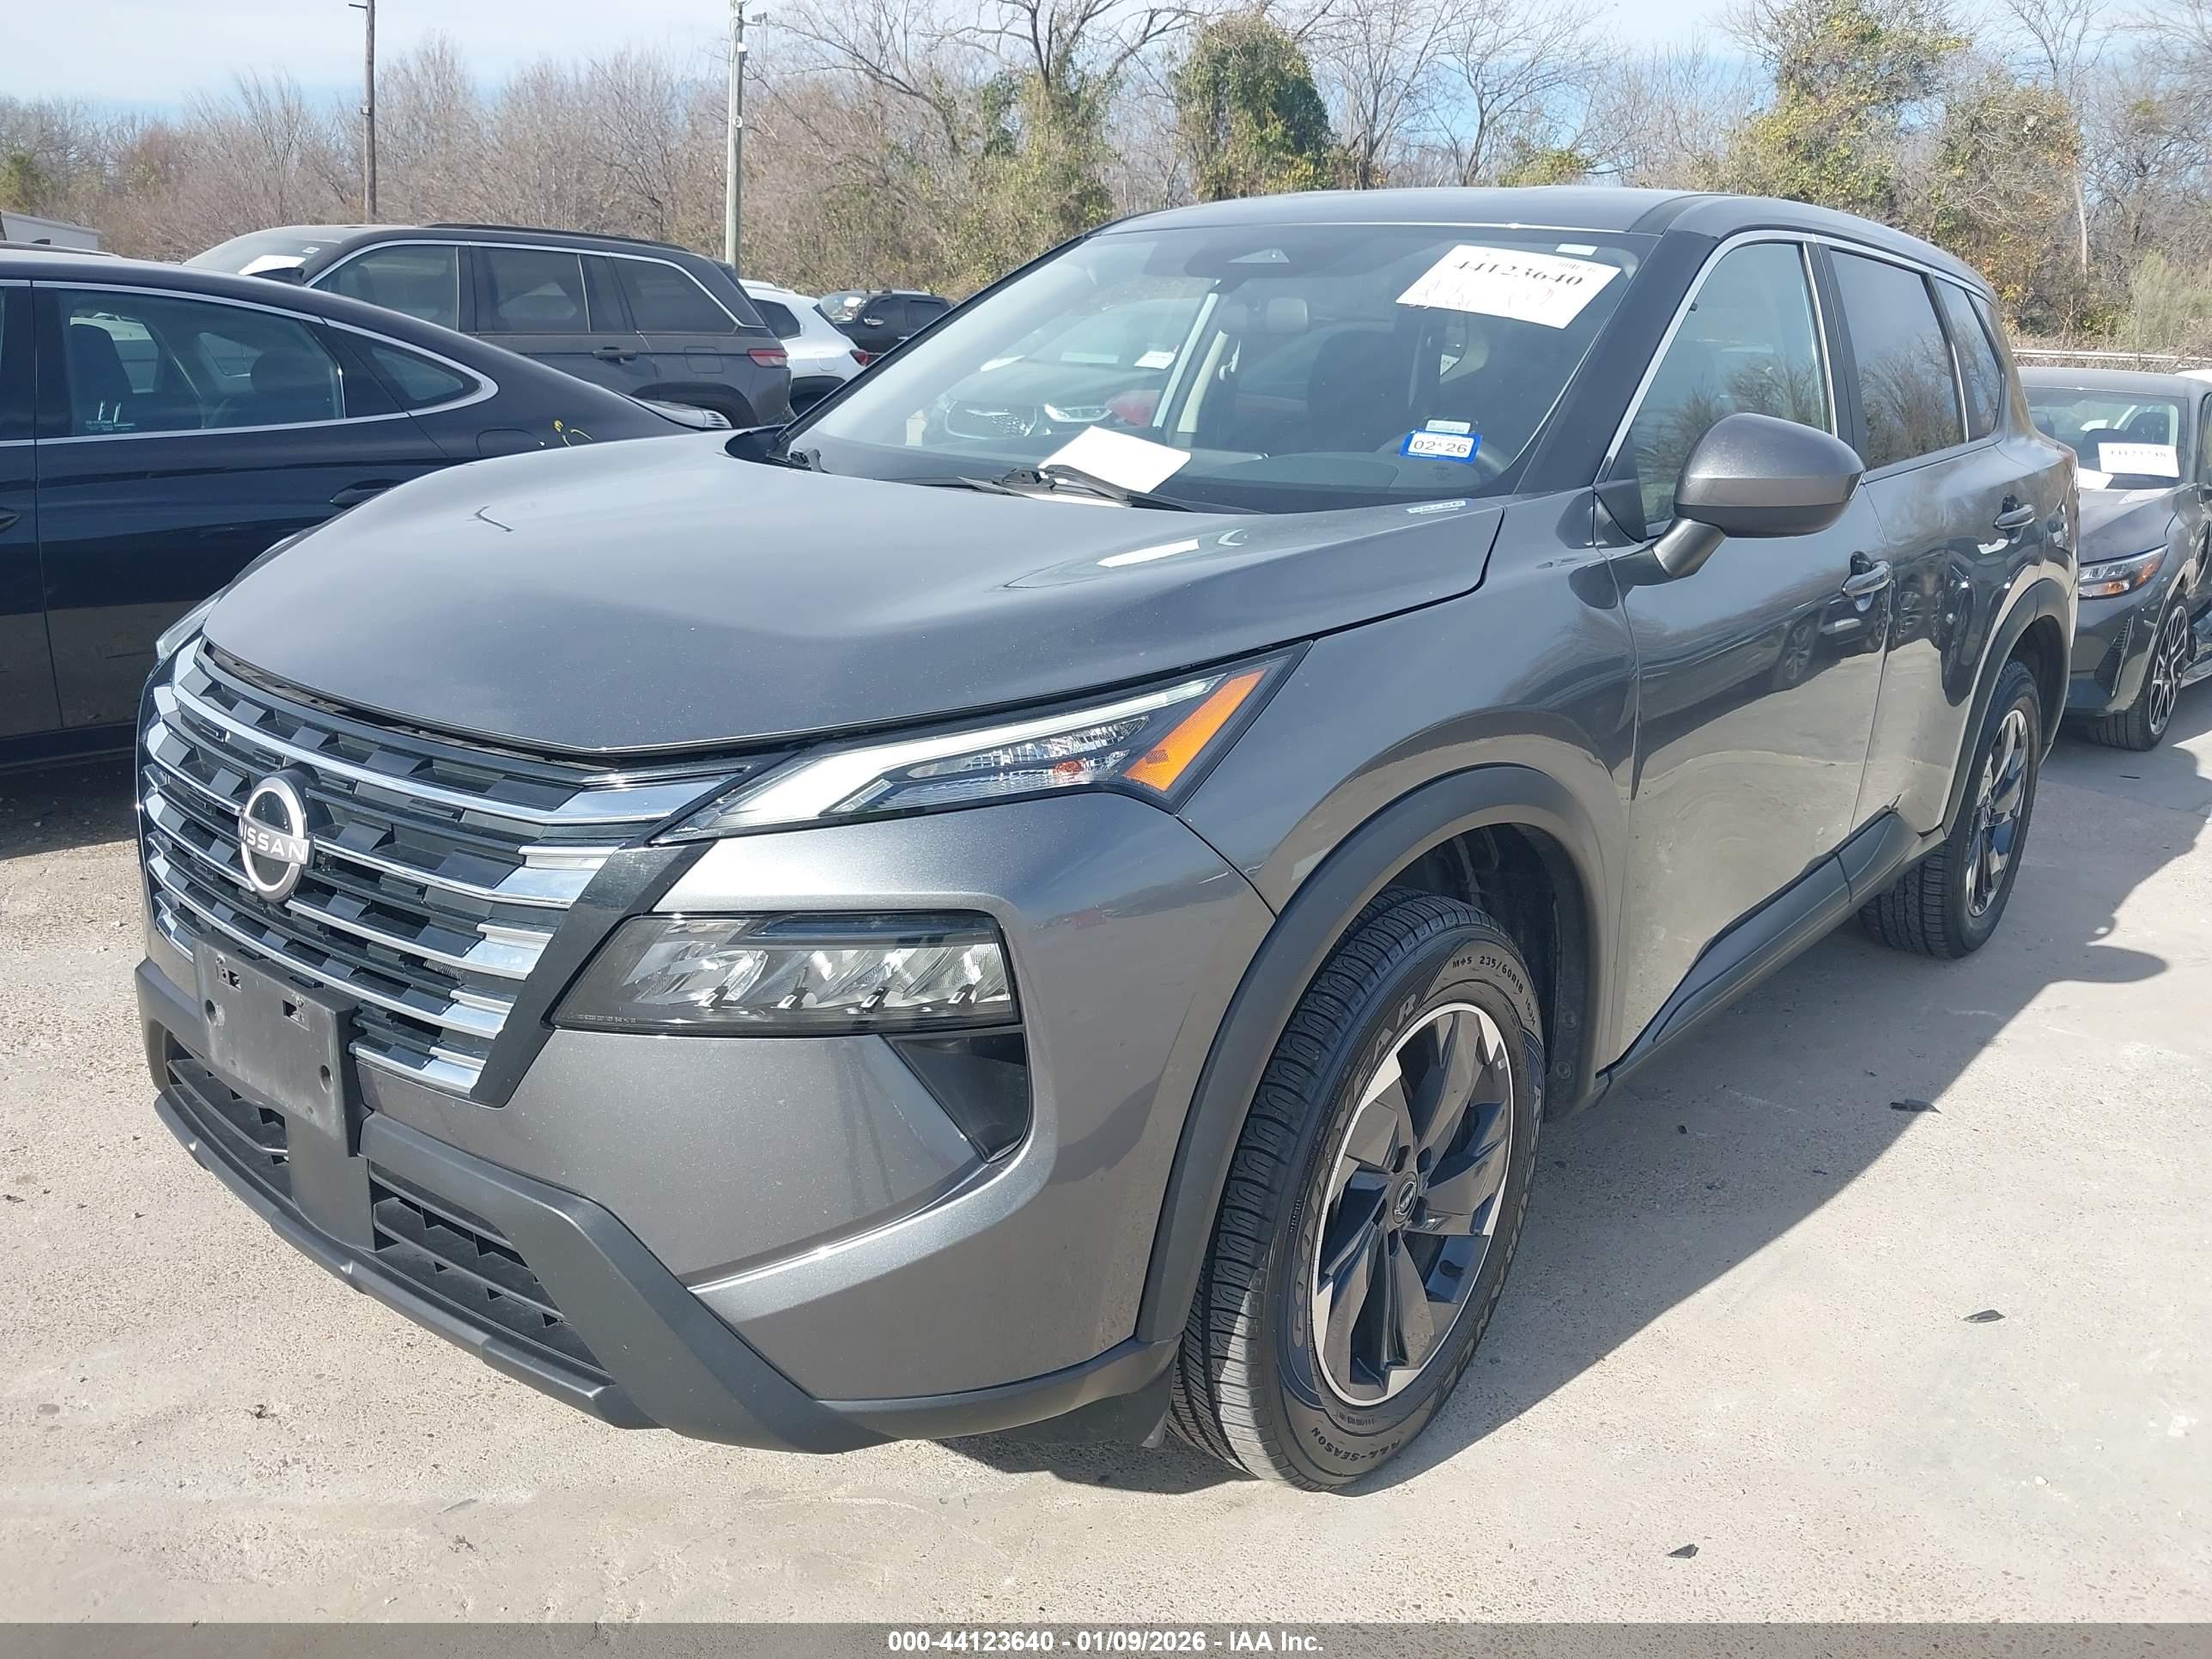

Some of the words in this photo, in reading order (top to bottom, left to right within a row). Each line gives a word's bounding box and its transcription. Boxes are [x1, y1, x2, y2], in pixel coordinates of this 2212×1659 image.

[1453, 259, 1583, 286] 44123640
[239, 817, 306, 861] NISSAN
[1479, 956, 1523, 994] 235/60R18
[1291, 993, 1417, 1348] GOODYEAR
[1310, 1425, 1401, 1462] ALL-SEASON
